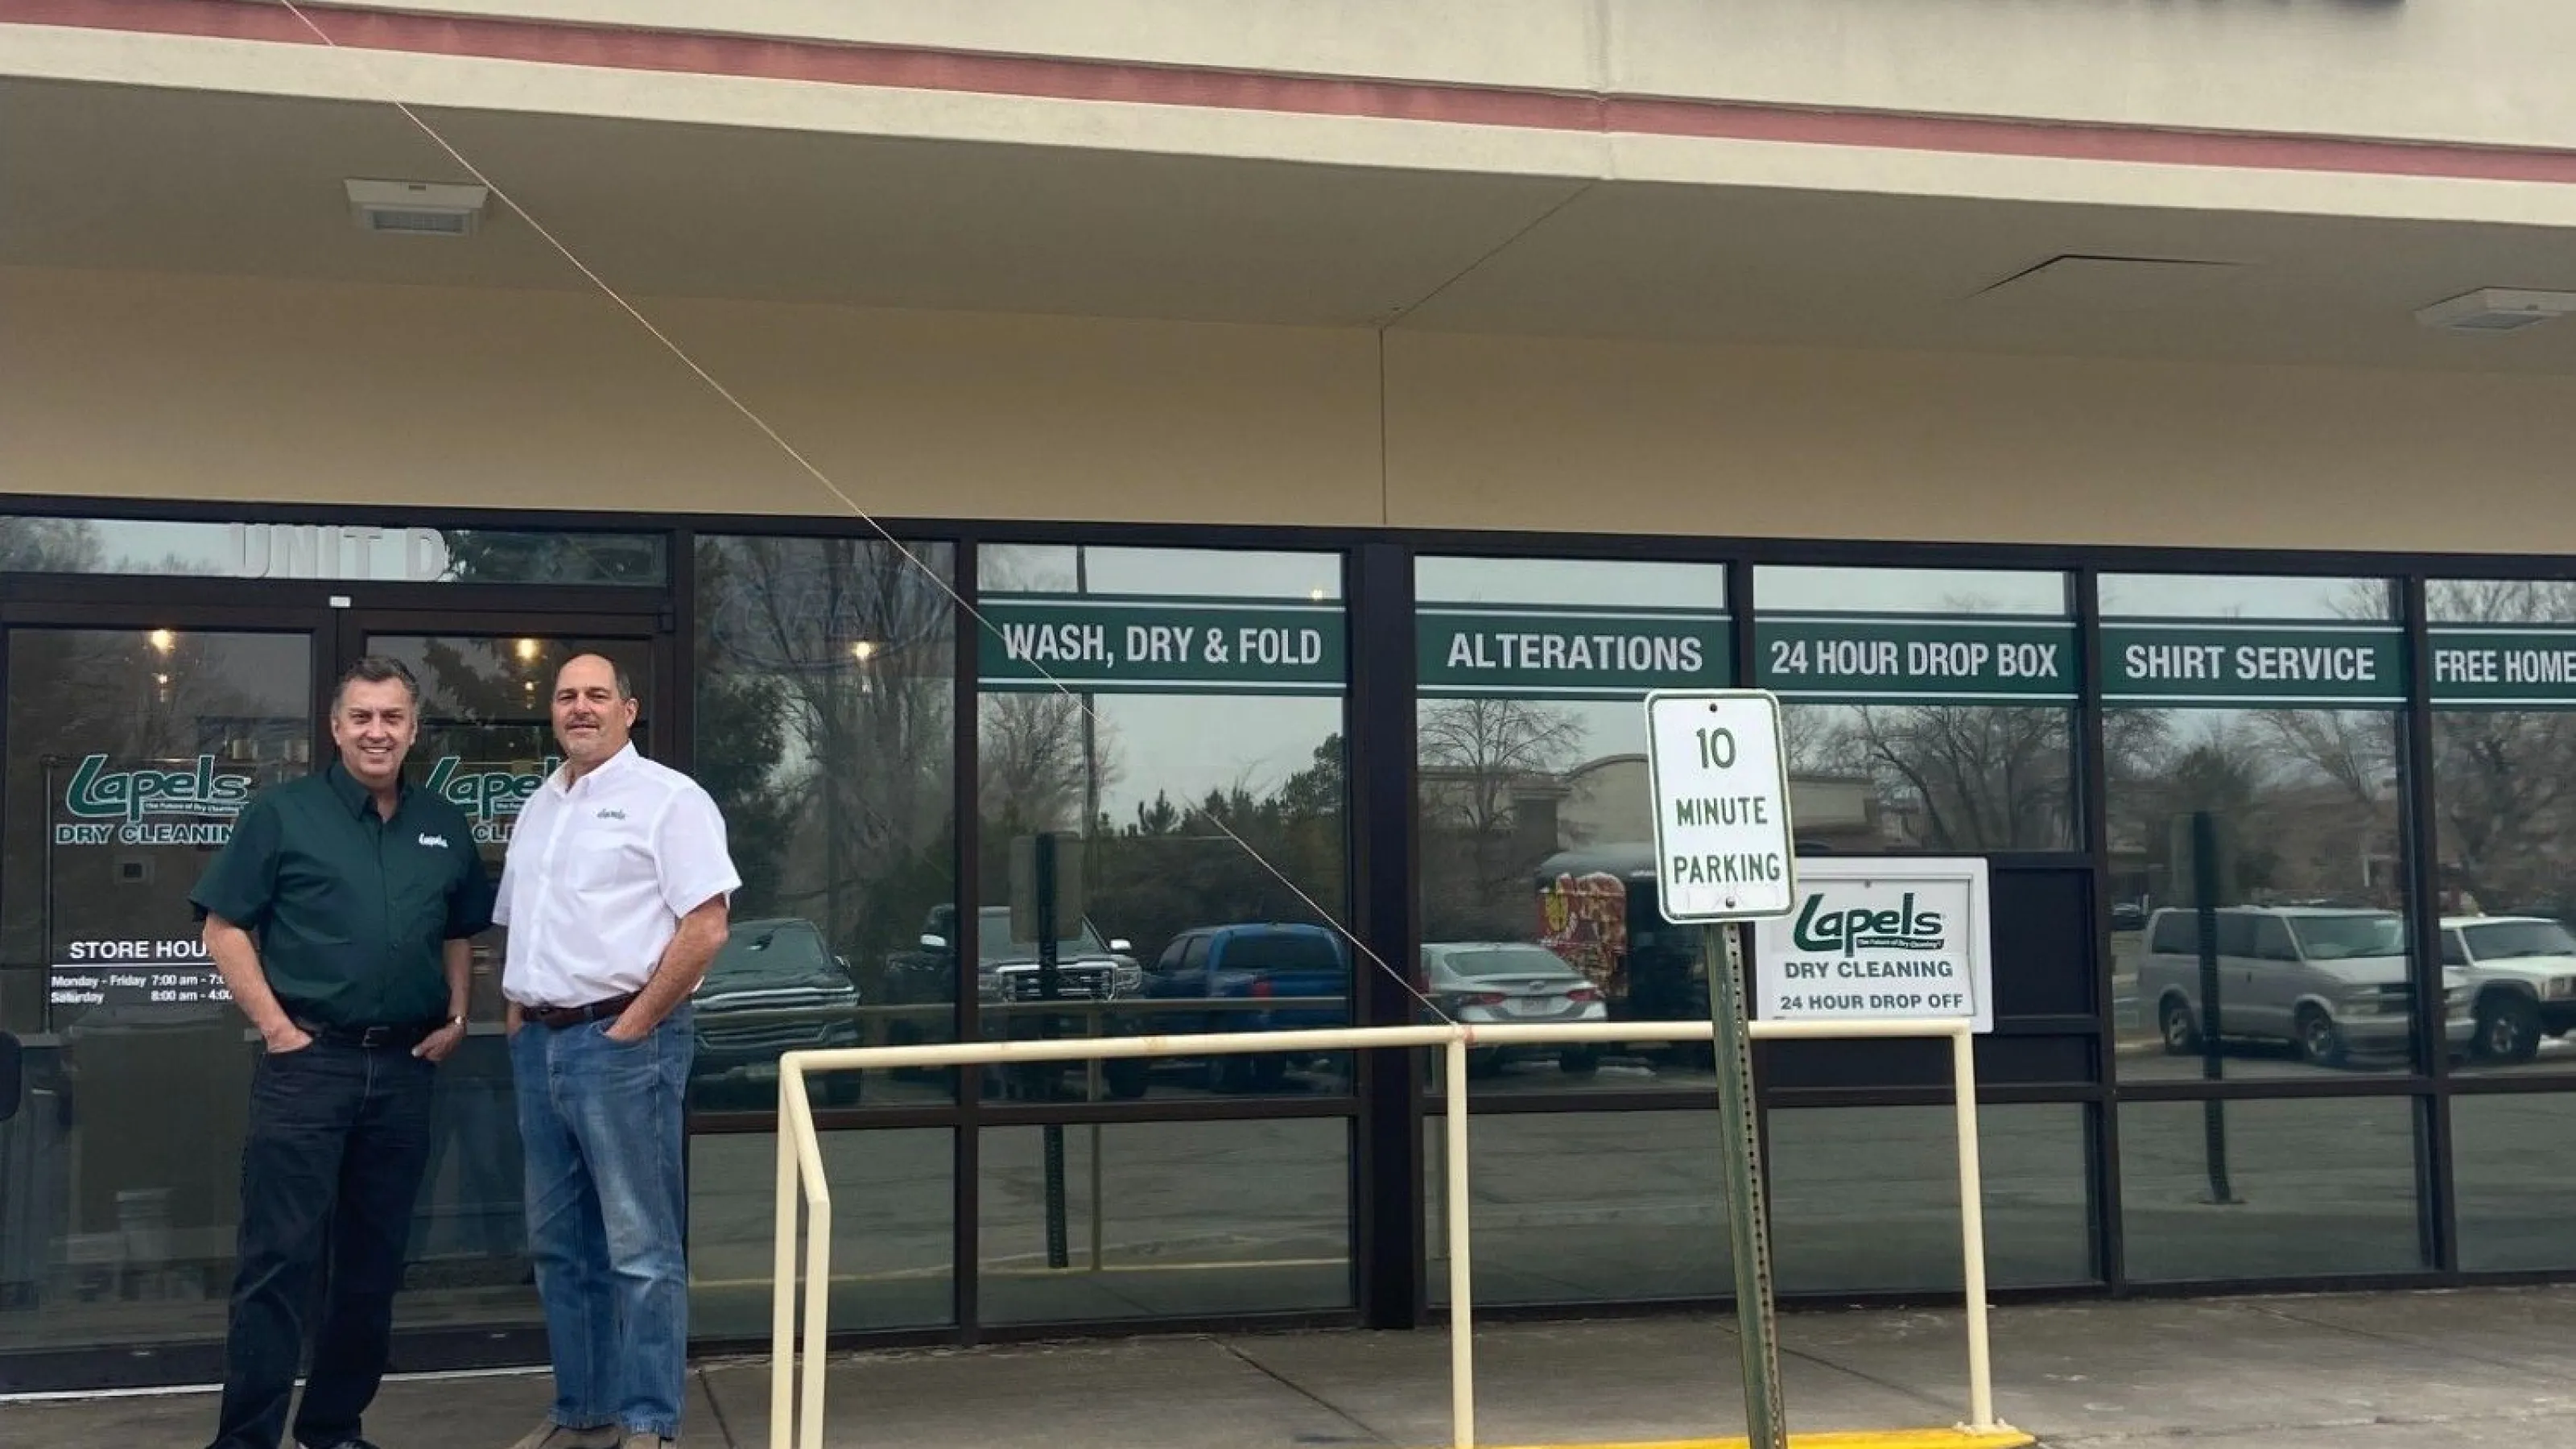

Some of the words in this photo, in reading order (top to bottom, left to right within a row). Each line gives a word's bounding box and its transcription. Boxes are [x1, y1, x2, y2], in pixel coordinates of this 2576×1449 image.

[229, 522, 383, 580] UNIT
[407, 526, 448, 581] D
[1003, 622, 1114, 668] WASH,
[1127, 625, 1194, 663] DRY
[1203, 628, 1228, 663] &
[1239, 628, 1322, 665] FOLD
[1447, 633, 1703, 672] ALTERATIONS
[1771, 640, 1809, 675] 24
[1816, 641, 1899, 675] HOUR
[1907, 642, 1989, 676] DROP
[1997, 643, 2058, 678] BOX
[2125, 645, 2225, 679] SHIRT
[2235, 645, 2376, 681] SERVICE
[2434, 649, 2499, 683] FREE
[2504, 650, 2576, 683] HOME
[1696, 727, 1736, 769] 10
[66, 753, 248, 824] Lapels
[1675, 796, 1768, 827] MINUTE
[56, 824, 114, 844] DRY
[119, 823, 234, 845] CLEANIN
[1673, 852, 1781, 884] PARKING
[1794, 892, 1944, 958] Lapels
[69, 940, 151, 959] STORE
[155, 939, 207, 958] HOU
[51, 975, 98, 989] Monday
[109, 974, 147, 989] Friday
[151, 974, 177, 985] 7:00
[179, 976, 198, 985] am
[1785, 962, 1829, 979] DRY
[1837, 960, 1953, 979] CLEANING
[151, 990, 177, 1001] 8:00
[179, 992, 198, 1001] am
[1780, 996, 1802, 1010] 24
[1808, 995, 1864, 1009] HOUR
[1869, 993, 1922, 1009] DROP
[1928, 993, 1963, 1009] OFF
